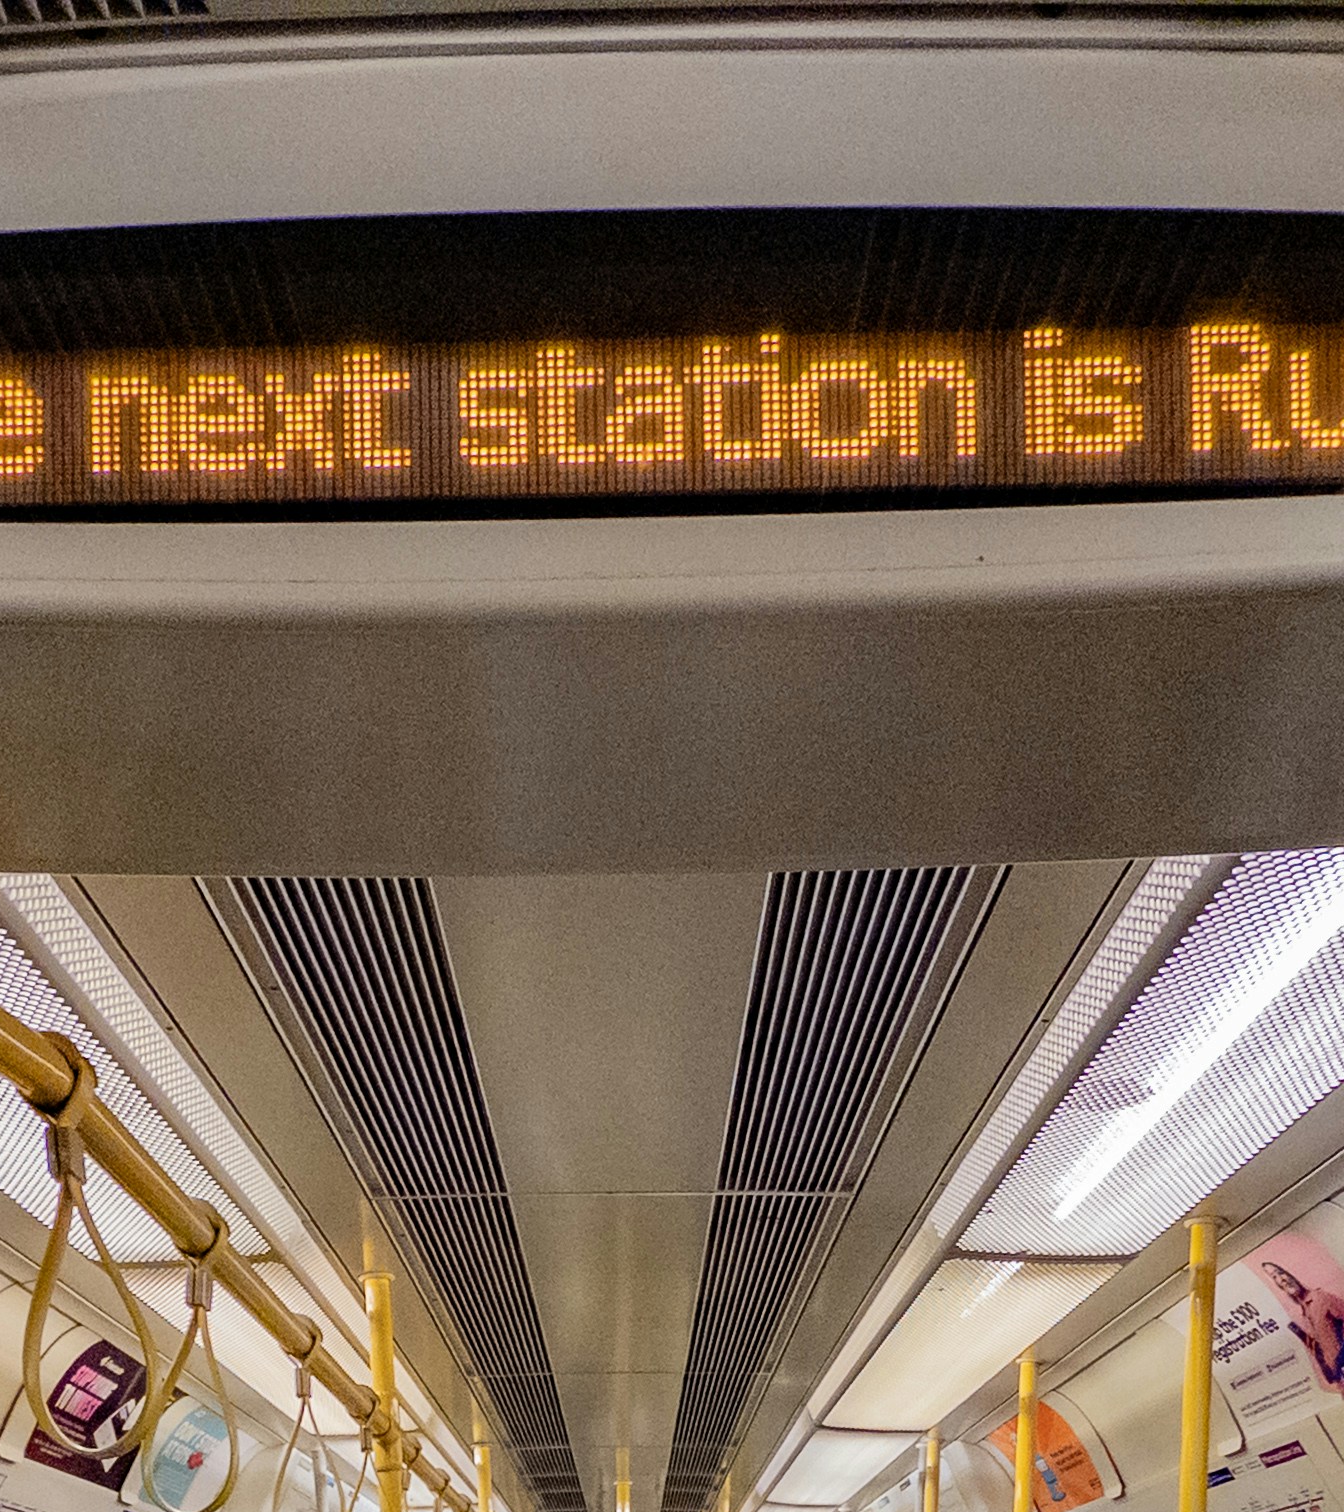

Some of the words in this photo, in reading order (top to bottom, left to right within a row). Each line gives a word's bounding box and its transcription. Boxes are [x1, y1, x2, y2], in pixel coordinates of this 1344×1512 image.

[89, 350, 411, 473] next
[458, 333, 977, 467] station
[1023, 326, 1144, 455] is
[1256, 1317, 1281, 1335] fee
